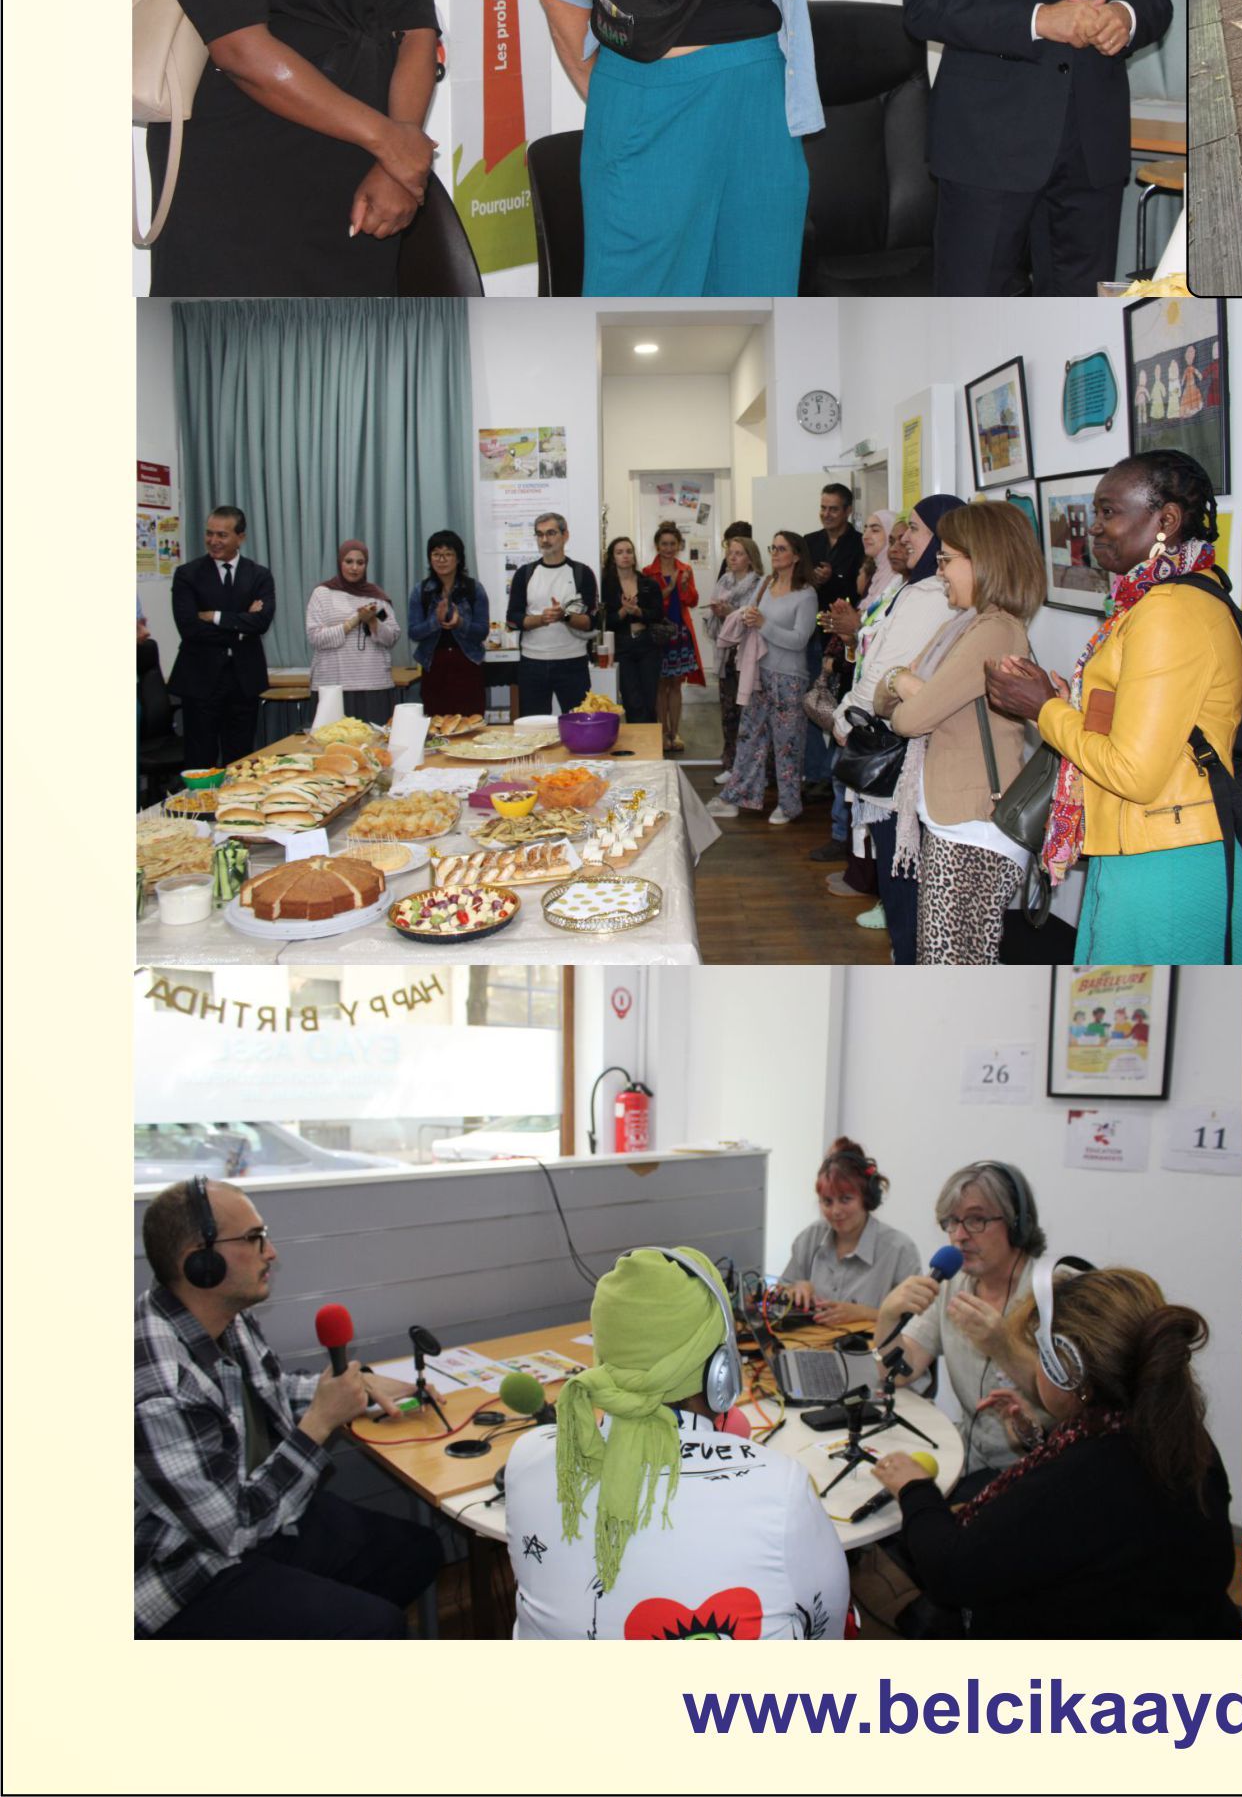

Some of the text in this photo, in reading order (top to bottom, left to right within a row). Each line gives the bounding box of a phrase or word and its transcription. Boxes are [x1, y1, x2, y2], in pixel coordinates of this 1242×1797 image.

[494, 41, 508, 72] Les
[470, 189, 531, 218] Pourquoi?
[981, 1064, 1010, 1084] 26
[1193, 1126, 1228, 1151] 11
[680, 1441, 756, 1460] EVER
